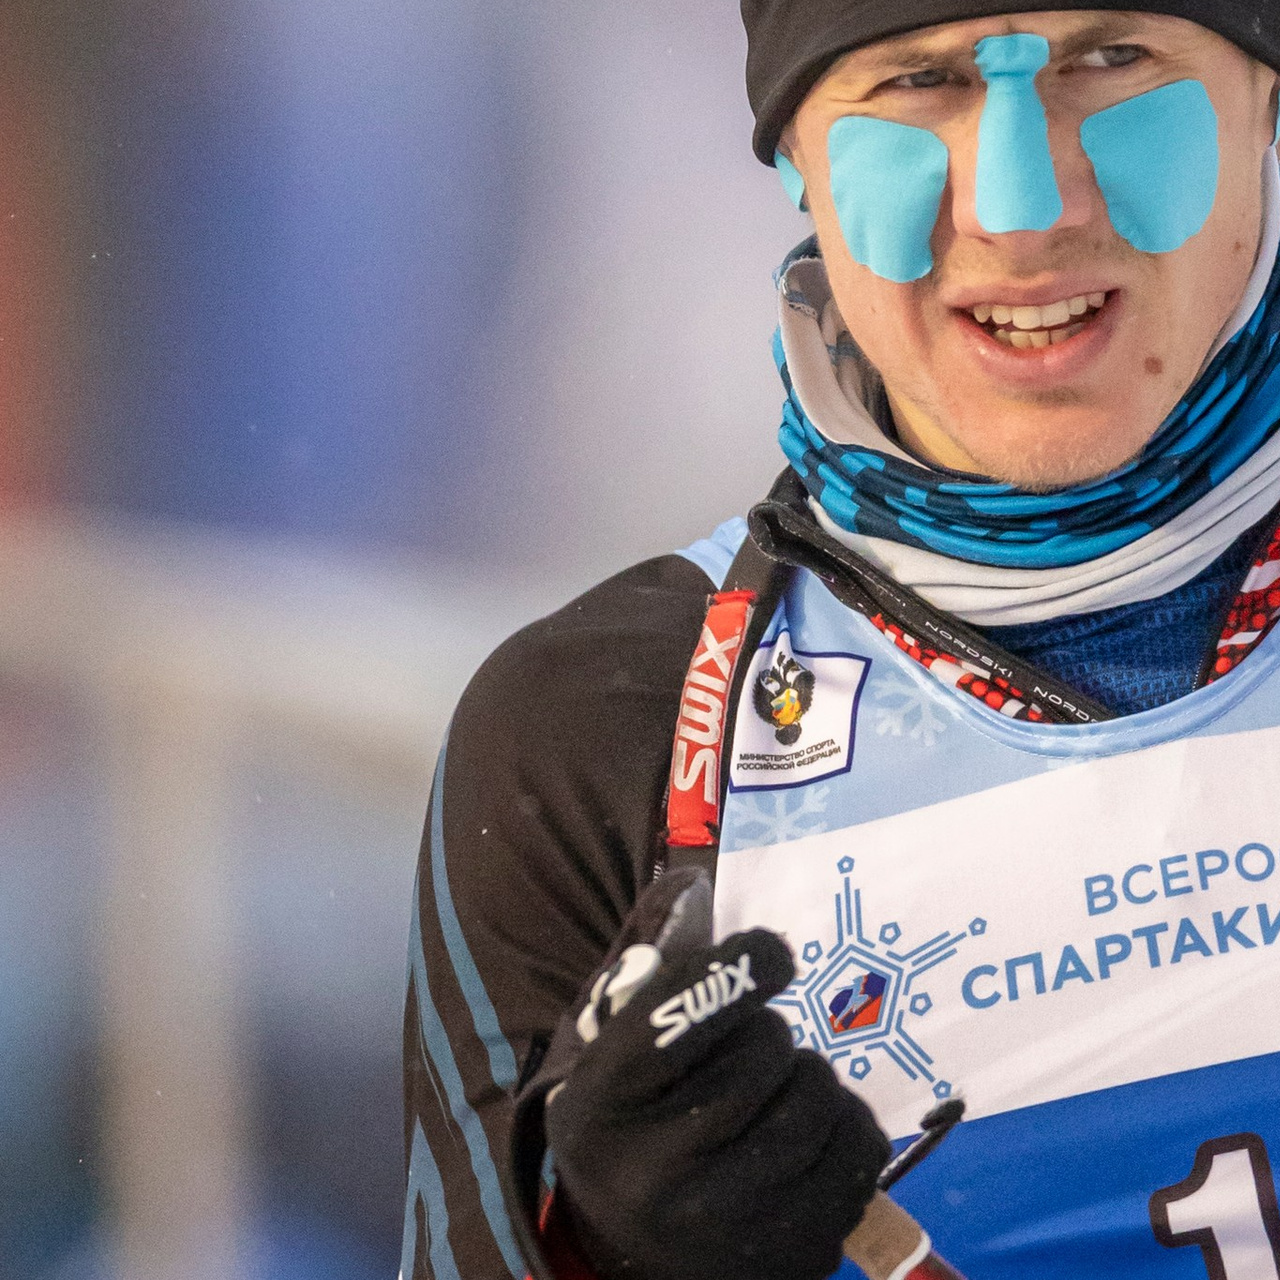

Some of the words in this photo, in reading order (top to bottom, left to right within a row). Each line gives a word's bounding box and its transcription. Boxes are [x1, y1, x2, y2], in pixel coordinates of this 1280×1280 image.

[925, 621, 1013, 678] NORDSKI
[1034, 686, 1098, 723] NORD
[736, 761, 795, 770] РОССИЙСКОЙ
[796, 746, 842, 767] ФЕДЕРАЦИИ
[739, 749, 805, 762] МИНИСТЕРСТВО
[805, 738, 836, 754] СПОРТА
